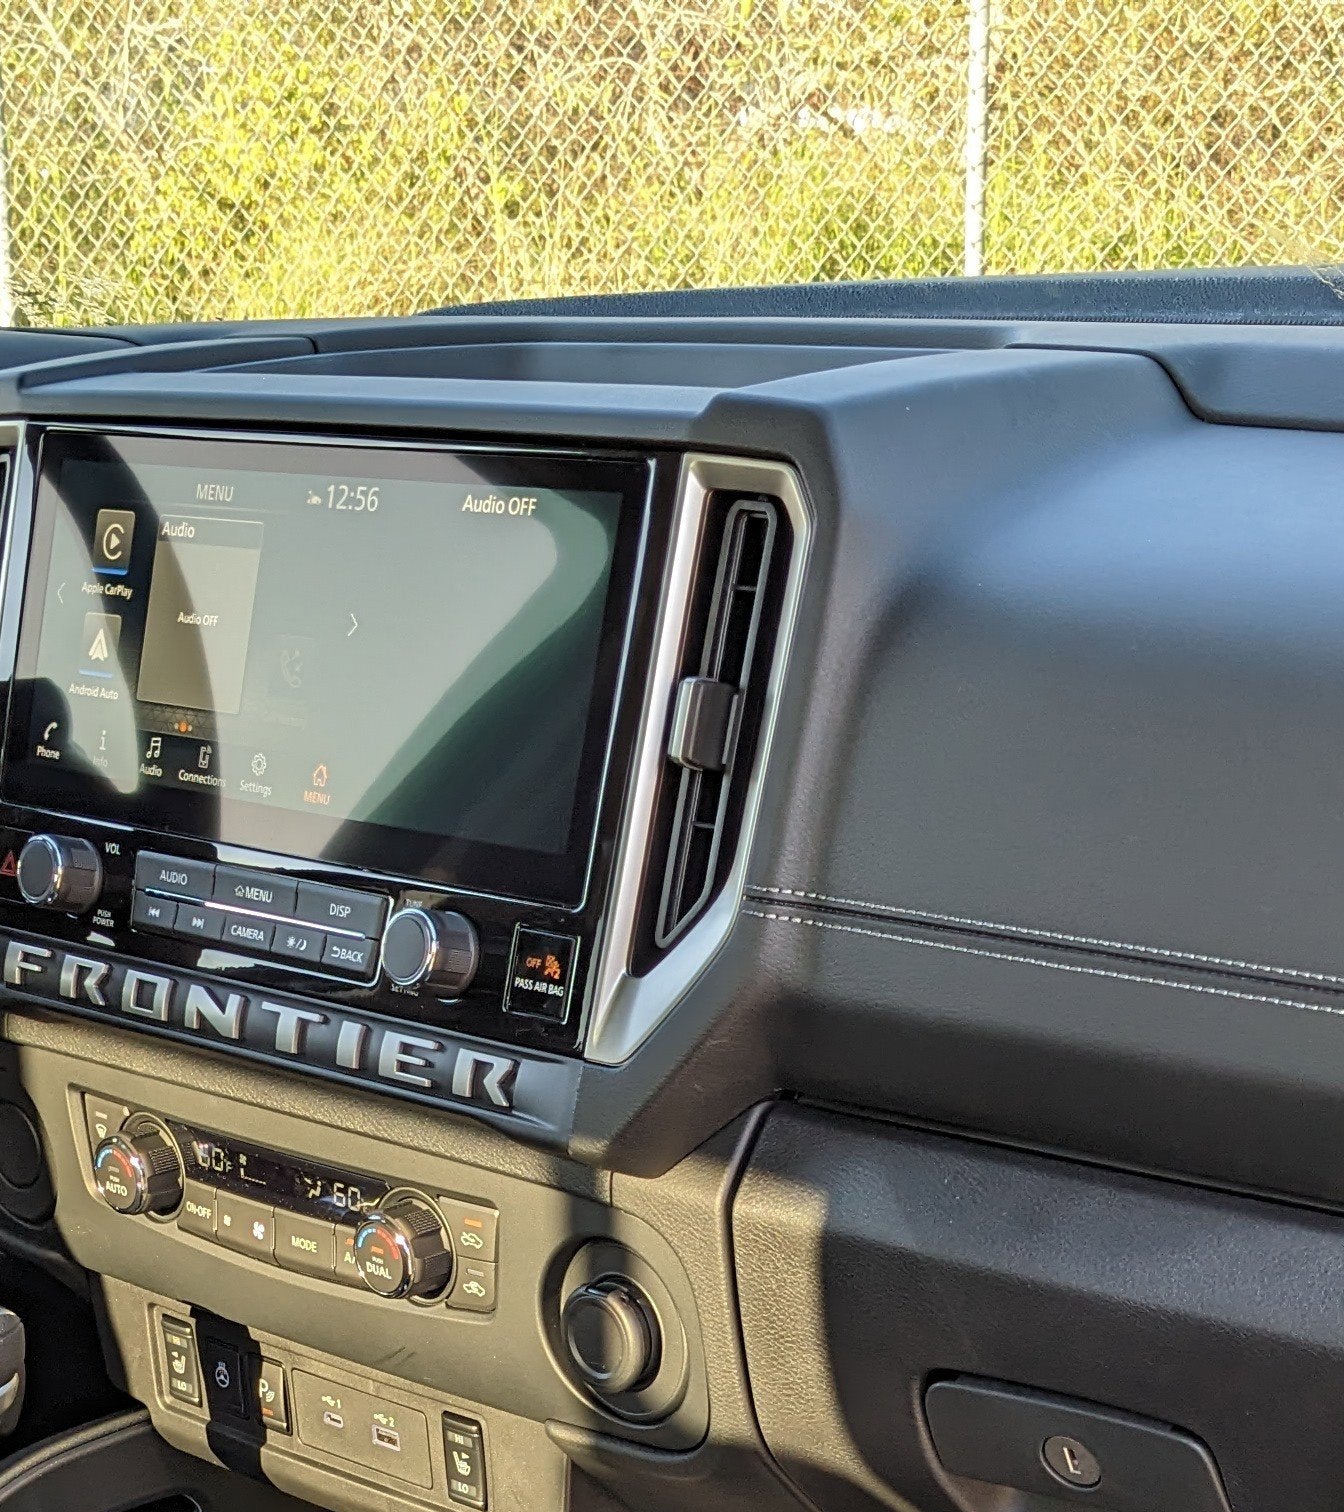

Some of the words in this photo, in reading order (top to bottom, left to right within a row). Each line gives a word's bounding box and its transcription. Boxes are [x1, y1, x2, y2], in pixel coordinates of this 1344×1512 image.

[196, 483, 235, 502] MENU
[326, 484, 380, 512] 12:56
[462, 494, 505, 514] Audio
[508, 497, 538, 516] OFF
[161, 521, 195, 539] Audio
[81, 581, 104, 596] Apple
[104, 583, 133, 600] CarPlay
[177, 611, 202, 626] Audio
[203, 614, 219, 627] OFF
[69, 683, 99, 698] Android
[99, 687, 119, 700] Auto
[36, 745, 60, 760] Phone
[140, 763, 163, 777] Audio
[178, 769, 227, 788] Connections
[239, 780, 272, 797] Settings
[304, 790, 331, 805] MENU
[105, 842, 121, 856] VOL
[159, 869, 188, 886] AUDIO
[245, 884, 273, 904] MENU
[329, 903, 351, 918] DISP
[92, 915, 115, 928] POWER
[230, 924, 264, 942] CAMERA
[340, 948, 365, 963] BACK
[525, 956, 542, 969] OFF
[515, 977, 534, 991] PASS
[534, 980, 547, 993] AIR
[547, 982, 565, 997] BAG
[4, 941, 519, 1108] FRONTIER
[105, 1181, 128, 1197] AUTO
[291, 1235, 318, 1253] MODE
[365, 1261, 392, 1280] DUAL
